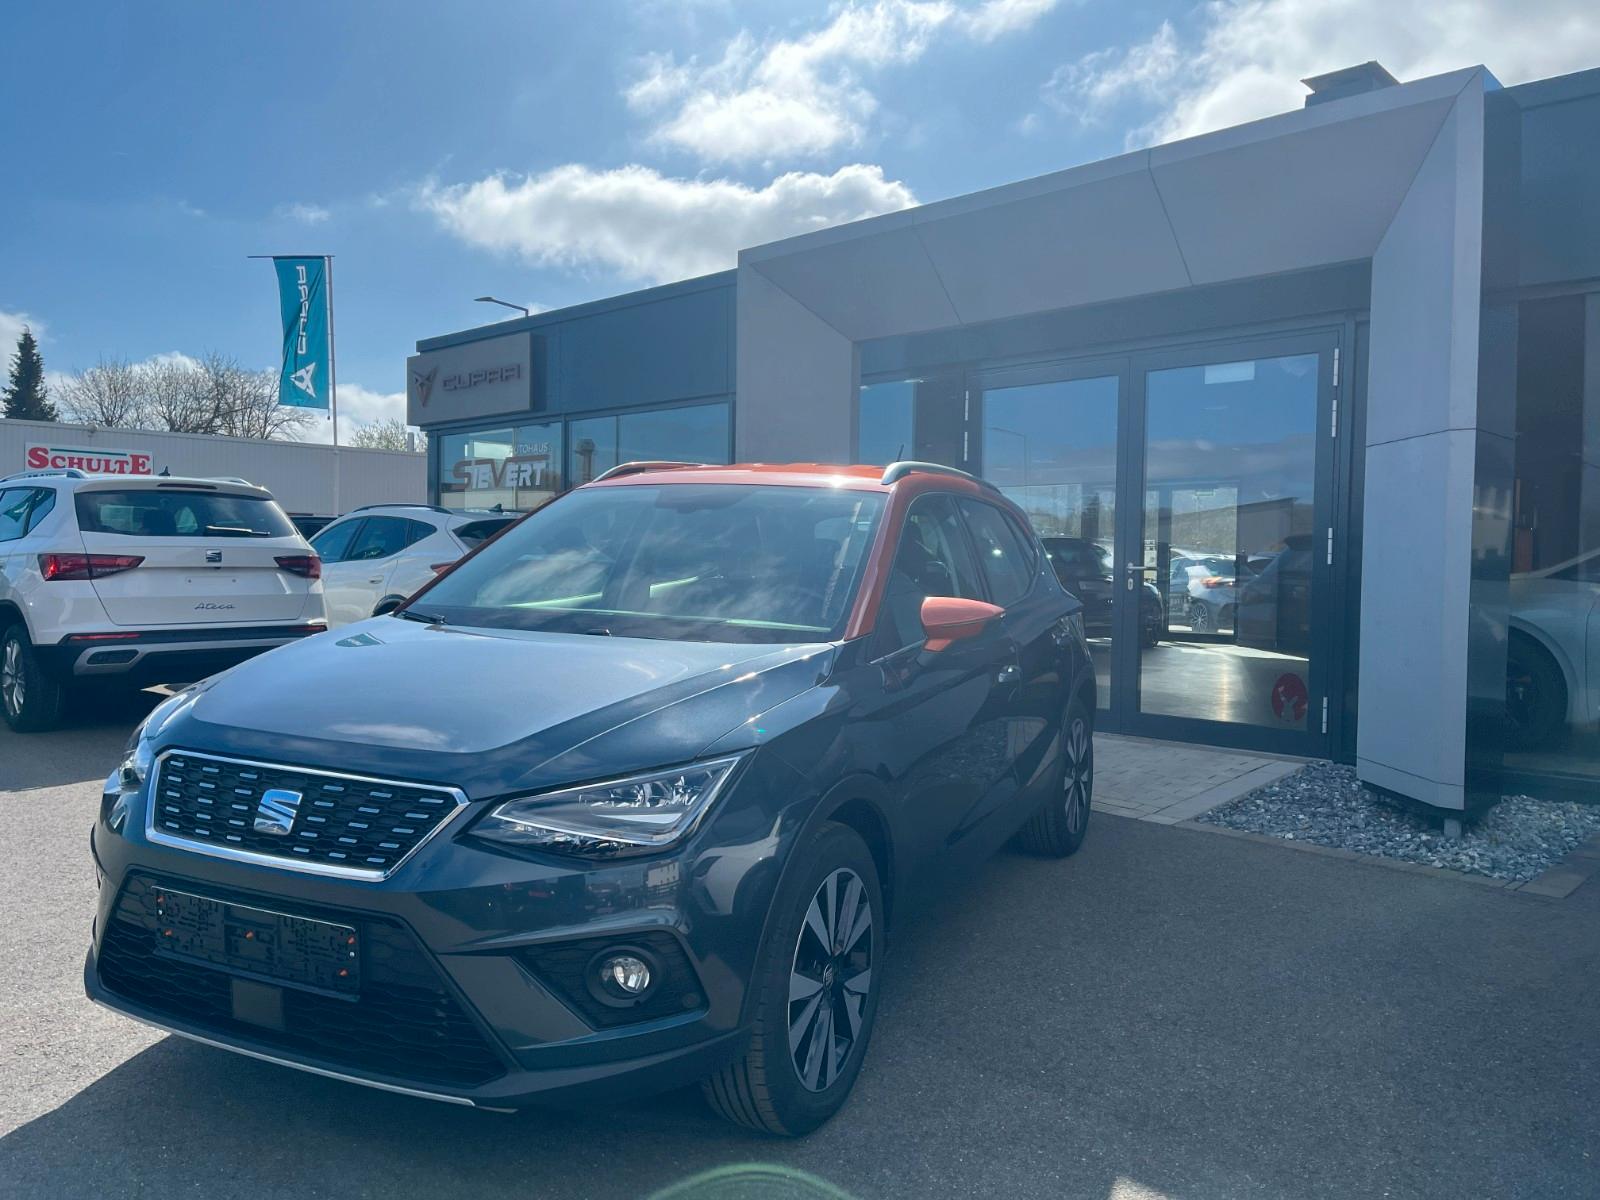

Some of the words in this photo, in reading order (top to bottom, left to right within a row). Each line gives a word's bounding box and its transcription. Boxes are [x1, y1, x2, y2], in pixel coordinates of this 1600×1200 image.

[442, 364, 521, 392] CUPRA
[27, 447, 152, 475] SCHULTE
[451, 454, 550, 491] SIEVERT
